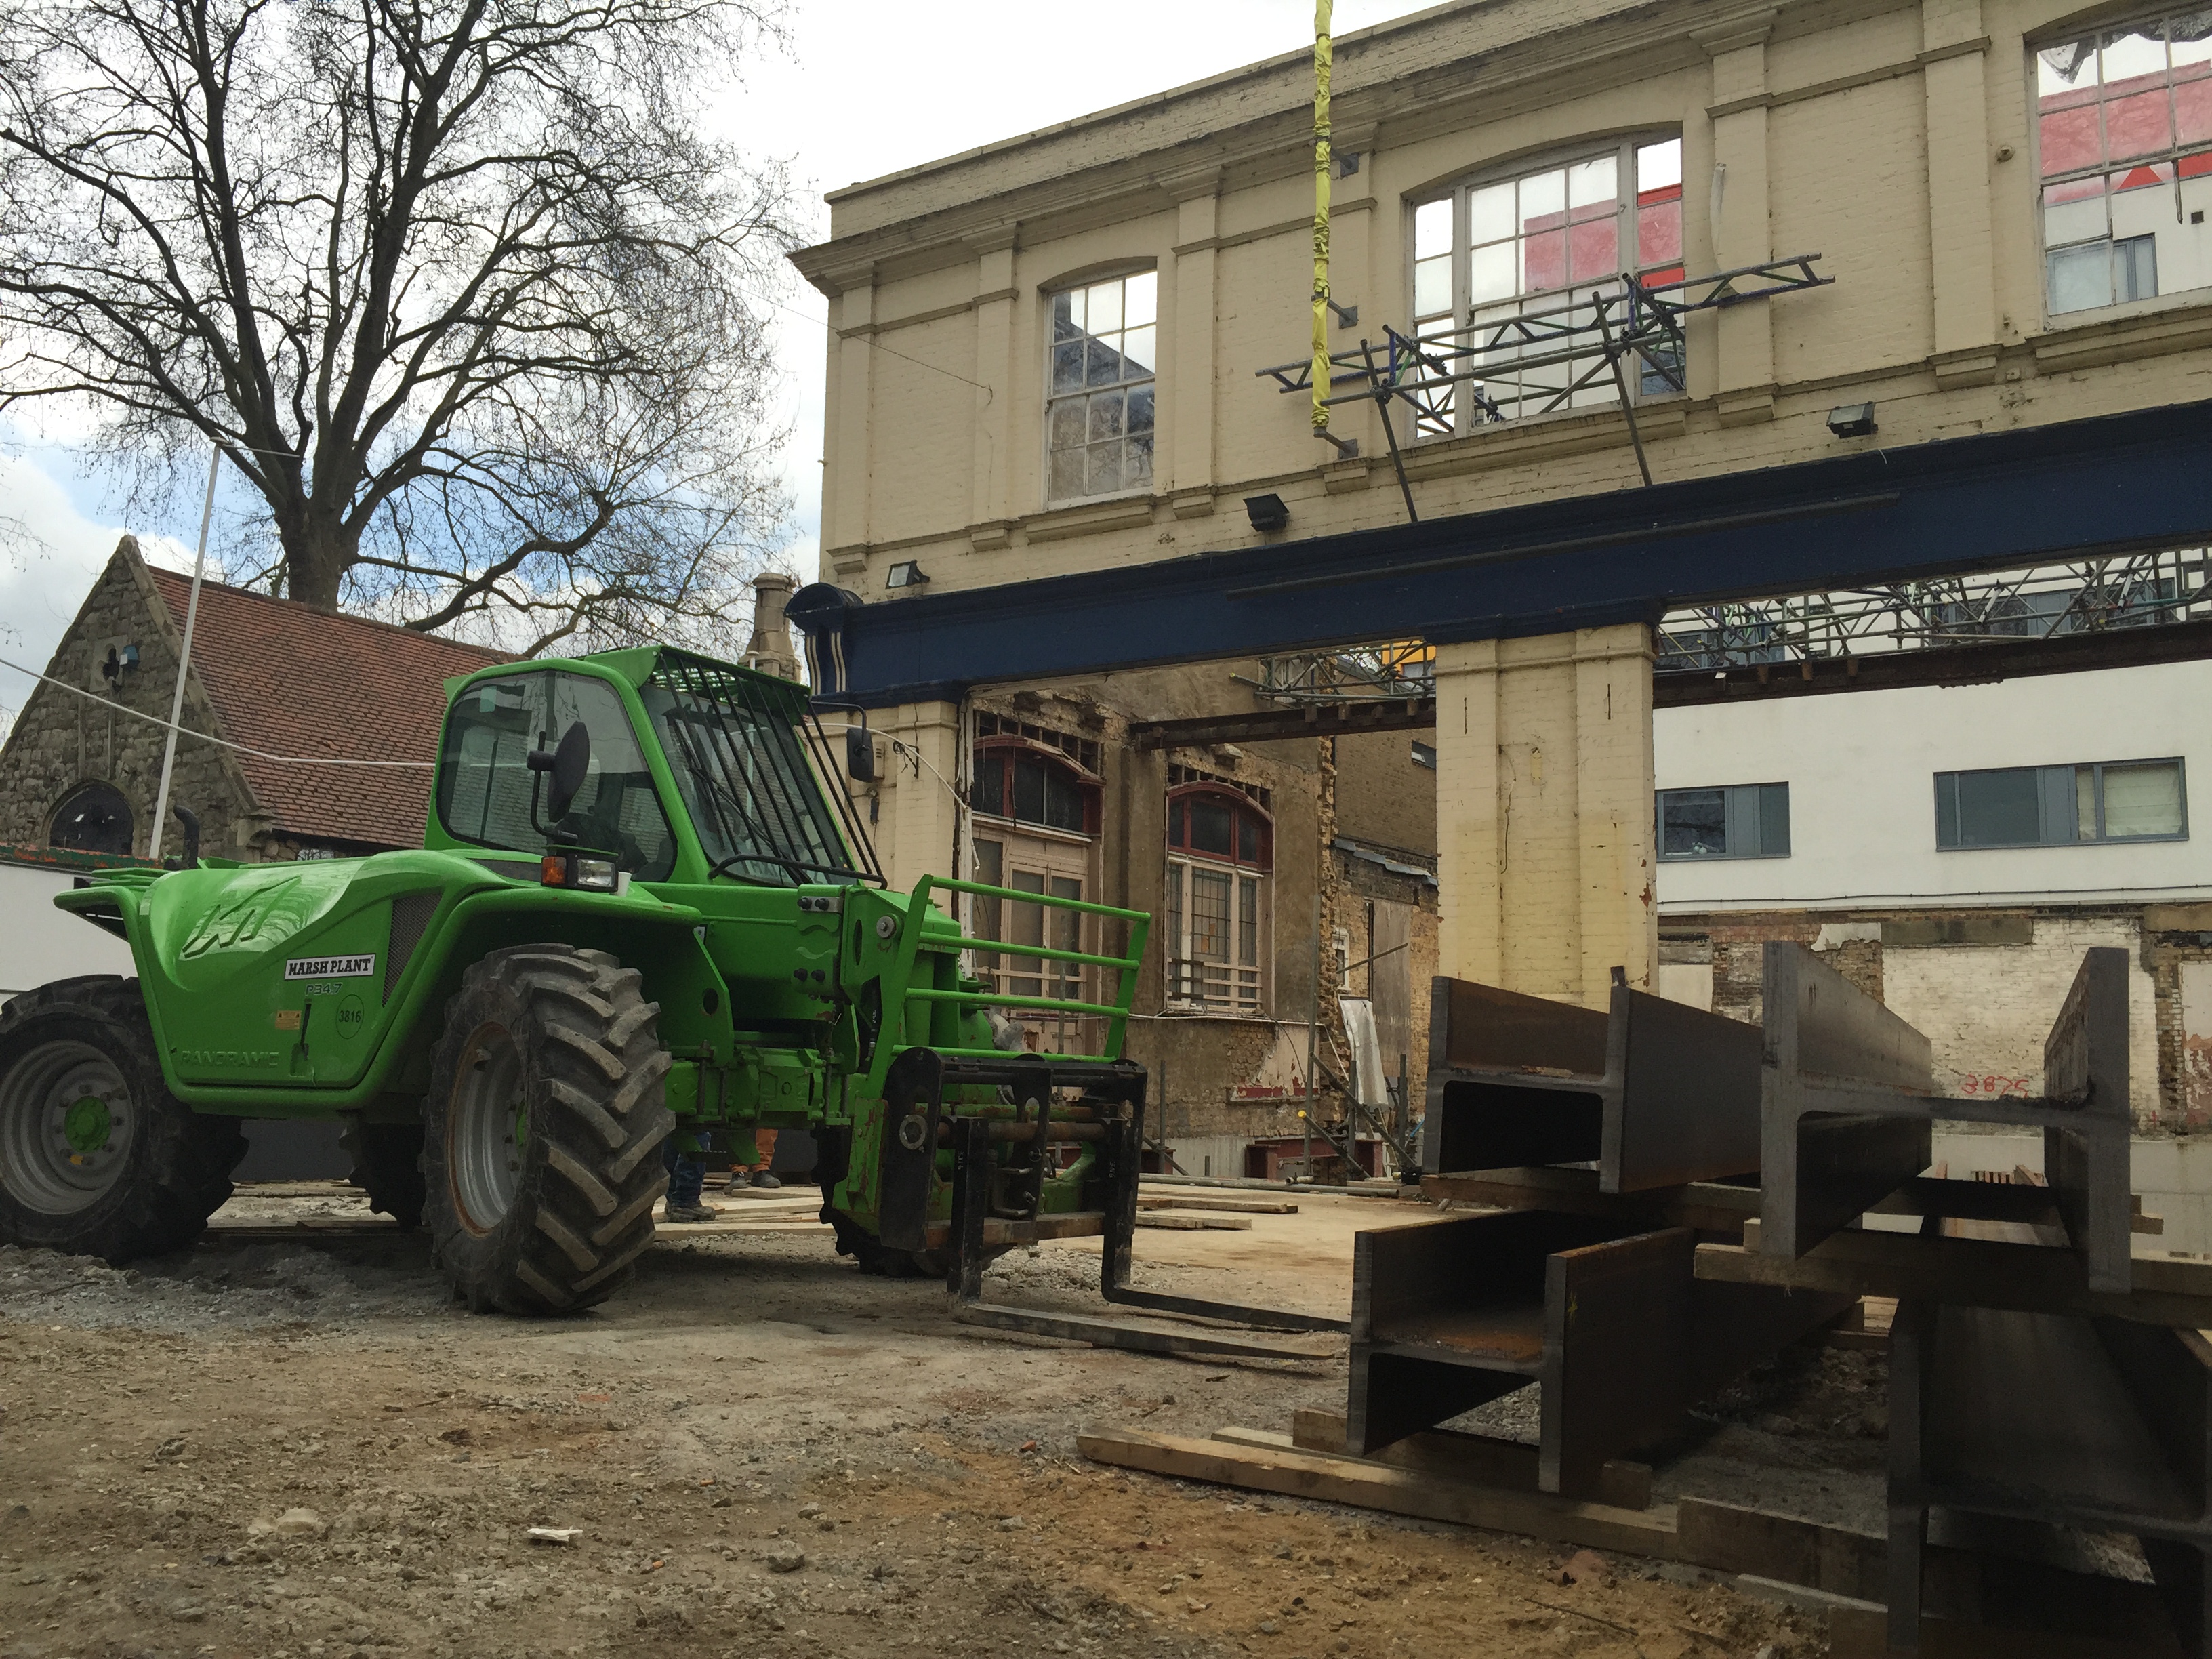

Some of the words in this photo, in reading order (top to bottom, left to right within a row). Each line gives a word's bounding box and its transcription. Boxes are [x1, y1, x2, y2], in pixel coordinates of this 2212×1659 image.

[288, 960, 329, 976] MARSH
[330, 958, 371, 974] PLANT
[306, 983, 343, 996] P34.7
[339, 1010, 361, 1023] 3816
